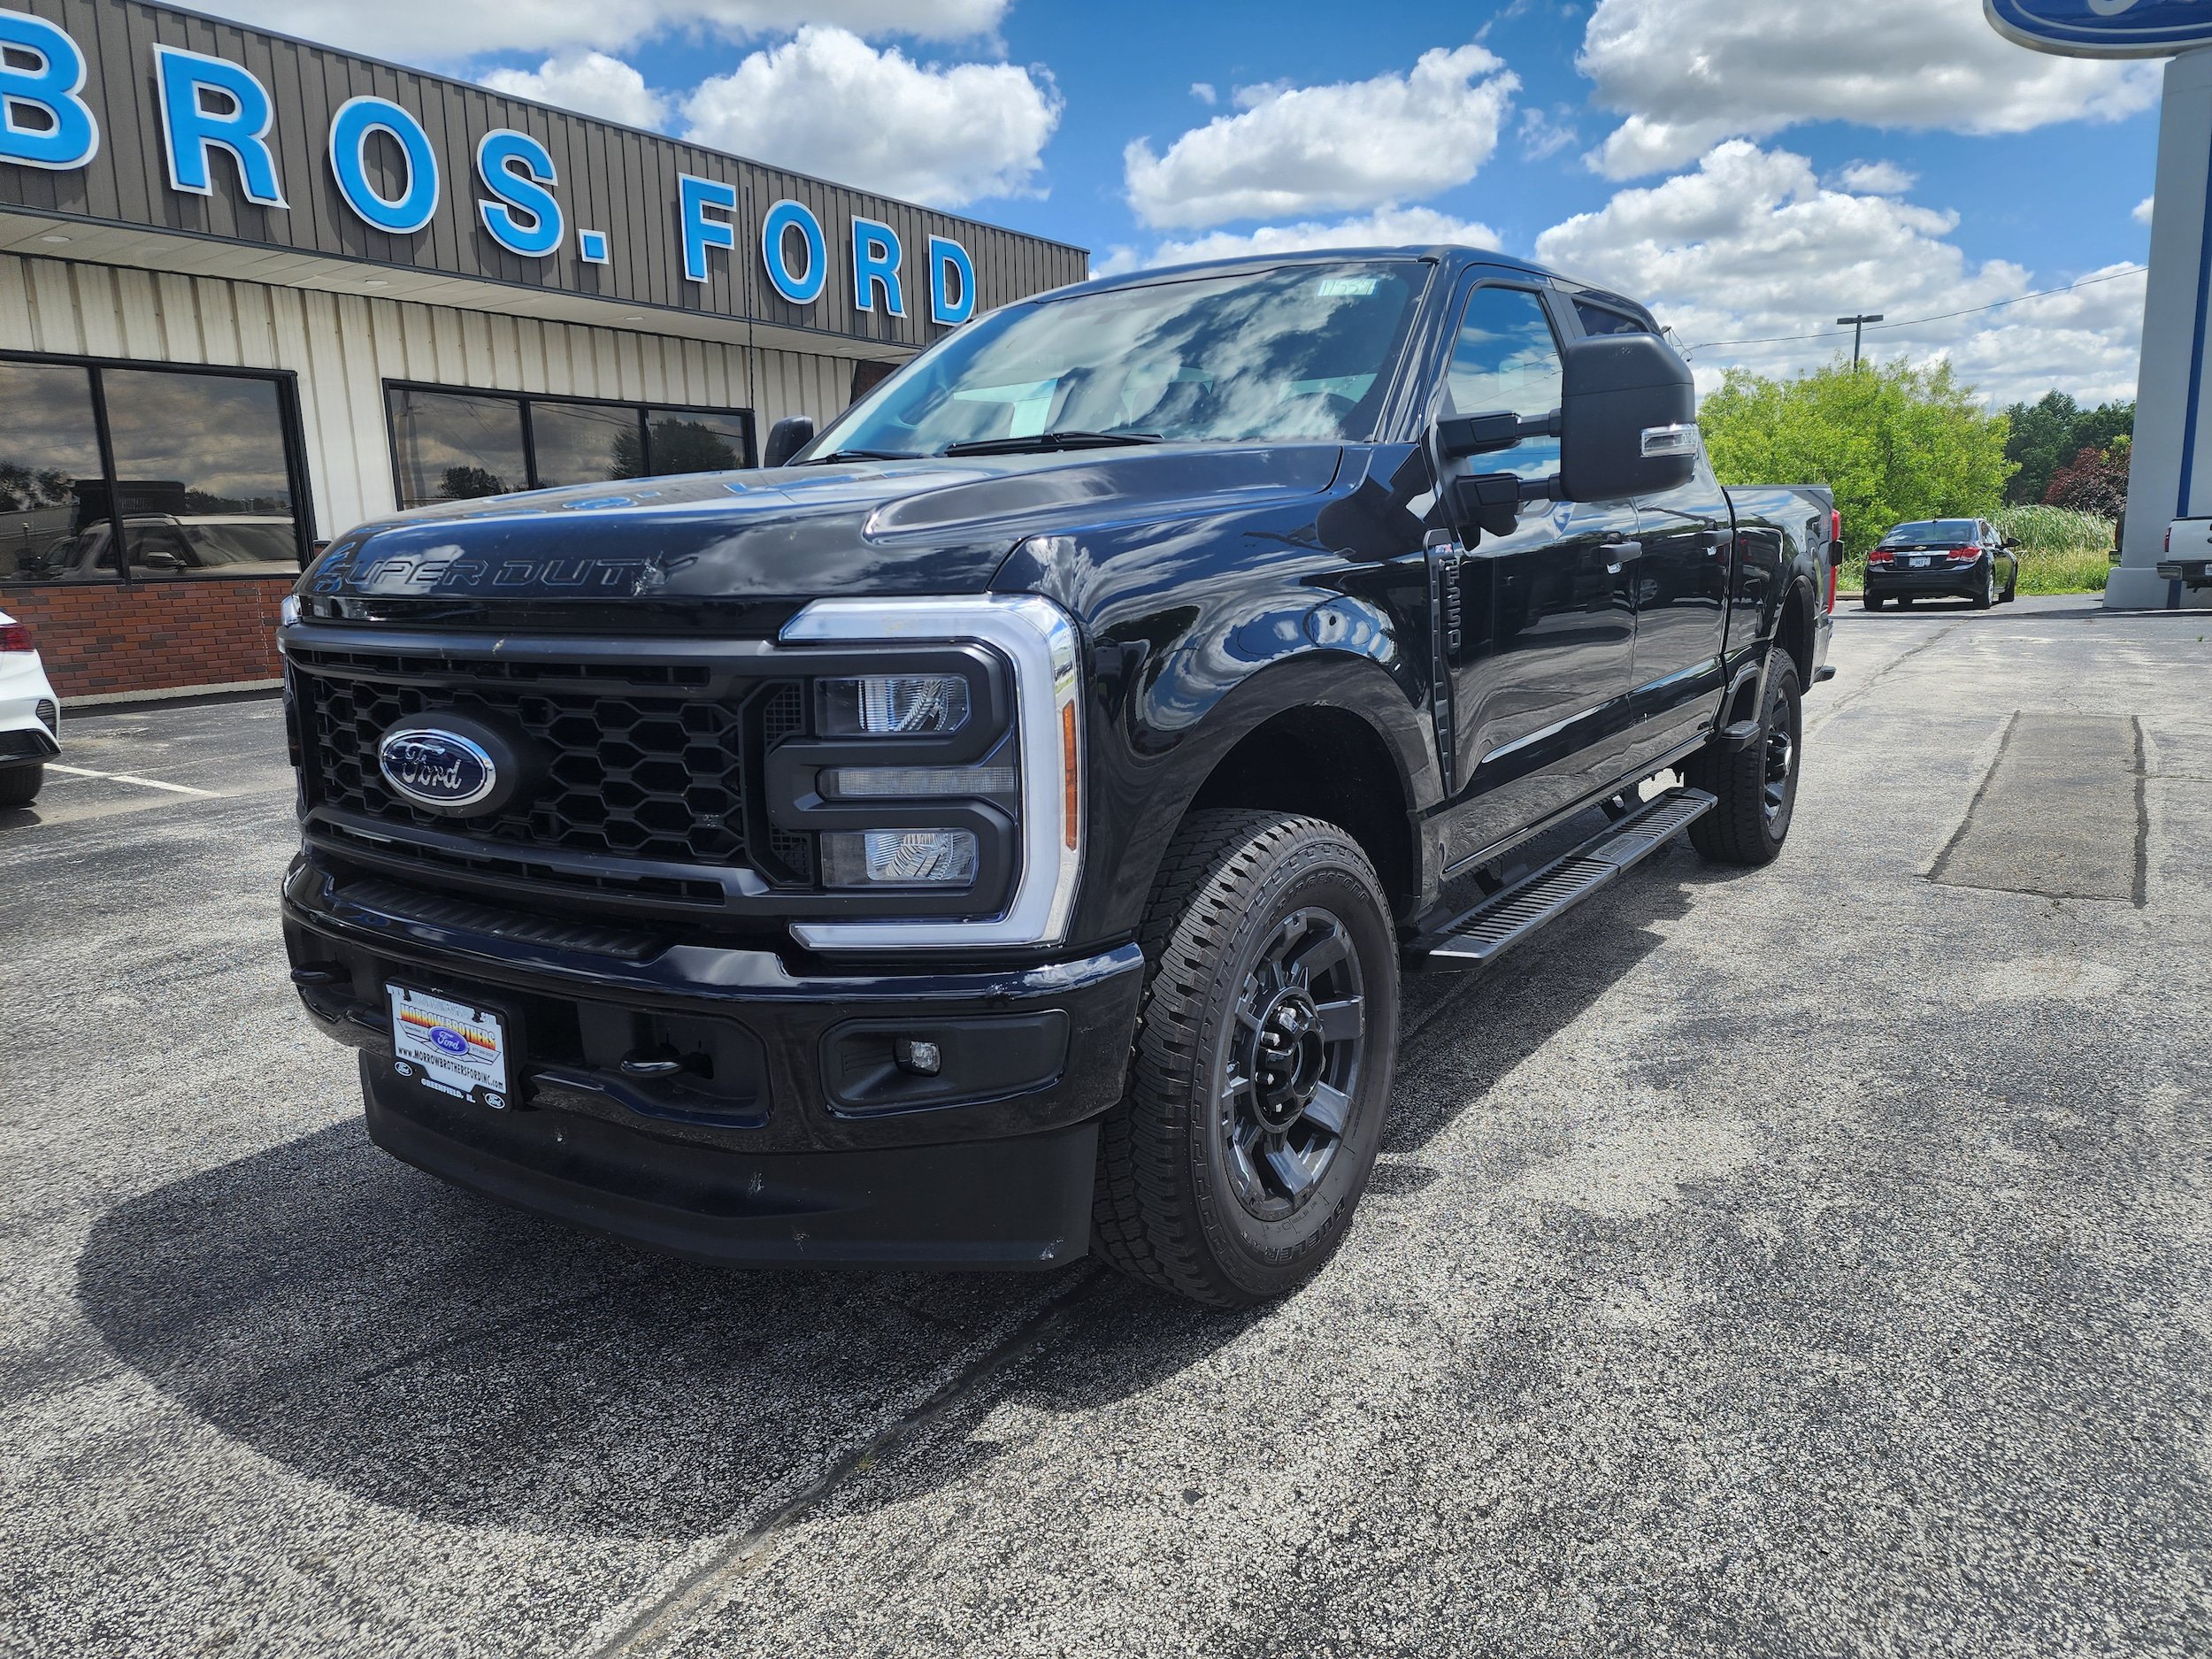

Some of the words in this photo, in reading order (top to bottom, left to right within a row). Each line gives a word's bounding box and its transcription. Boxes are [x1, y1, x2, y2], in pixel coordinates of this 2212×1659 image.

[0, 9, 609, 265] BROS.
[678, 173, 976, 326] FORD
[491, 556, 700, 588] DUTY
[393, 741, 463, 789] Ford
[438, 1031, 460, 1051] Ford
